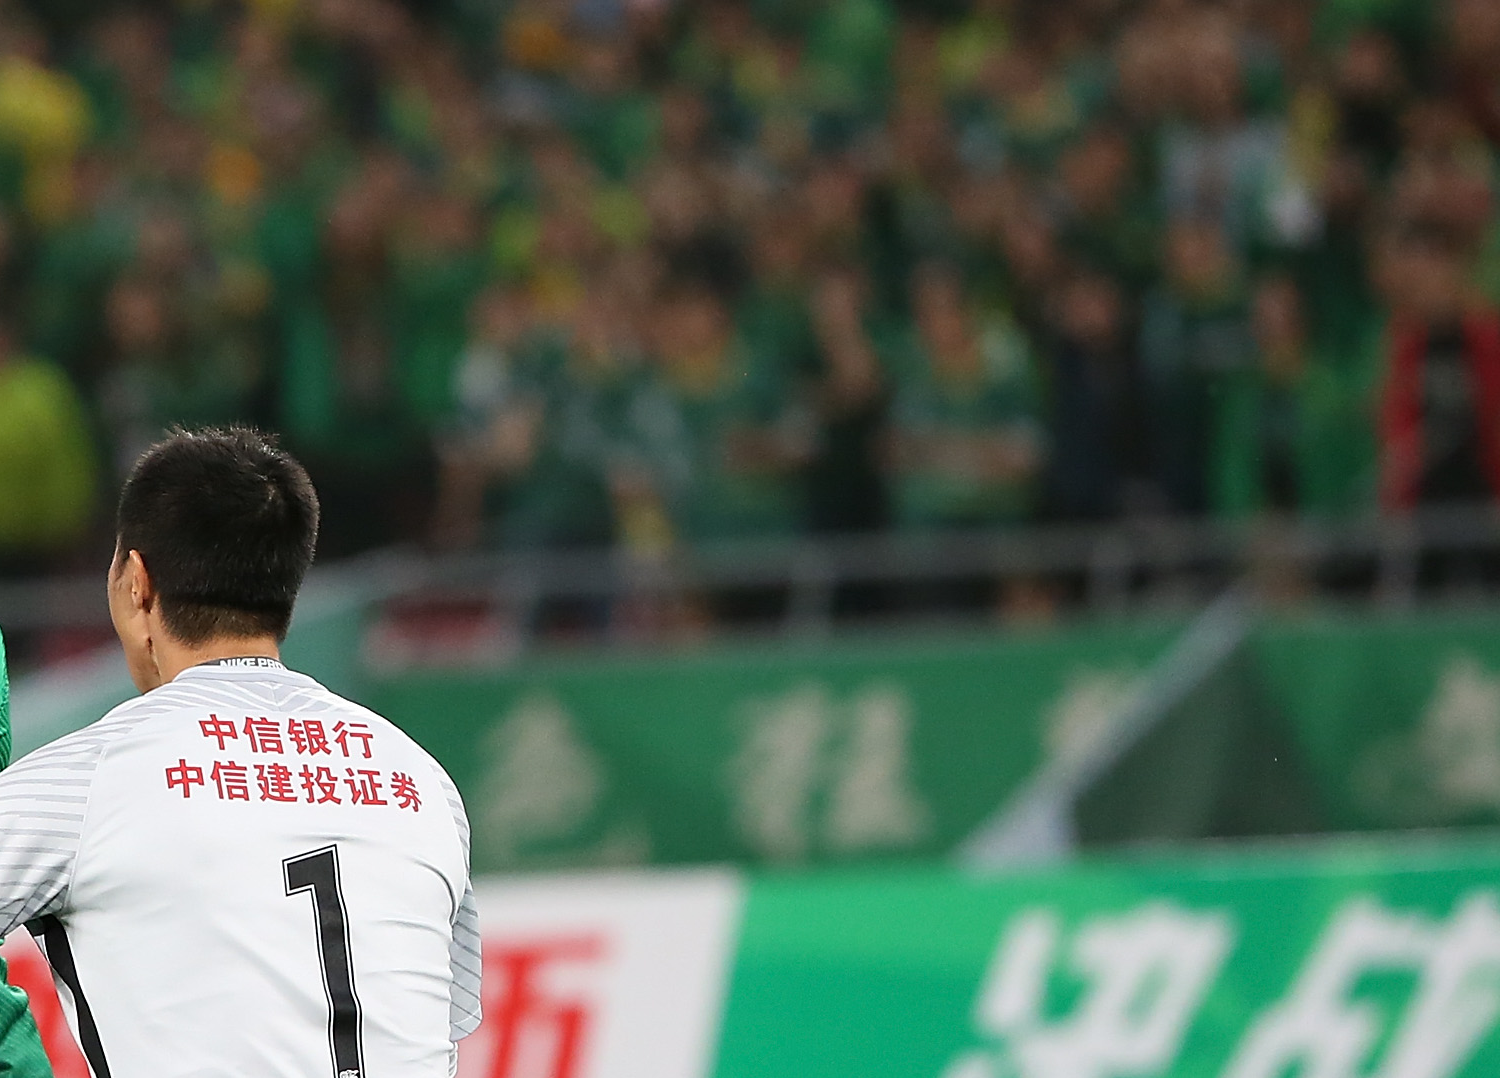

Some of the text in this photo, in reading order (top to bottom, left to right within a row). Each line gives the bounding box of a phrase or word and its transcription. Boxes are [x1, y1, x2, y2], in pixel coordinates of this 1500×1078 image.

[198, 714, 374, 758] 中信银行
[165, 758, 422, 813] 中信建投证券
